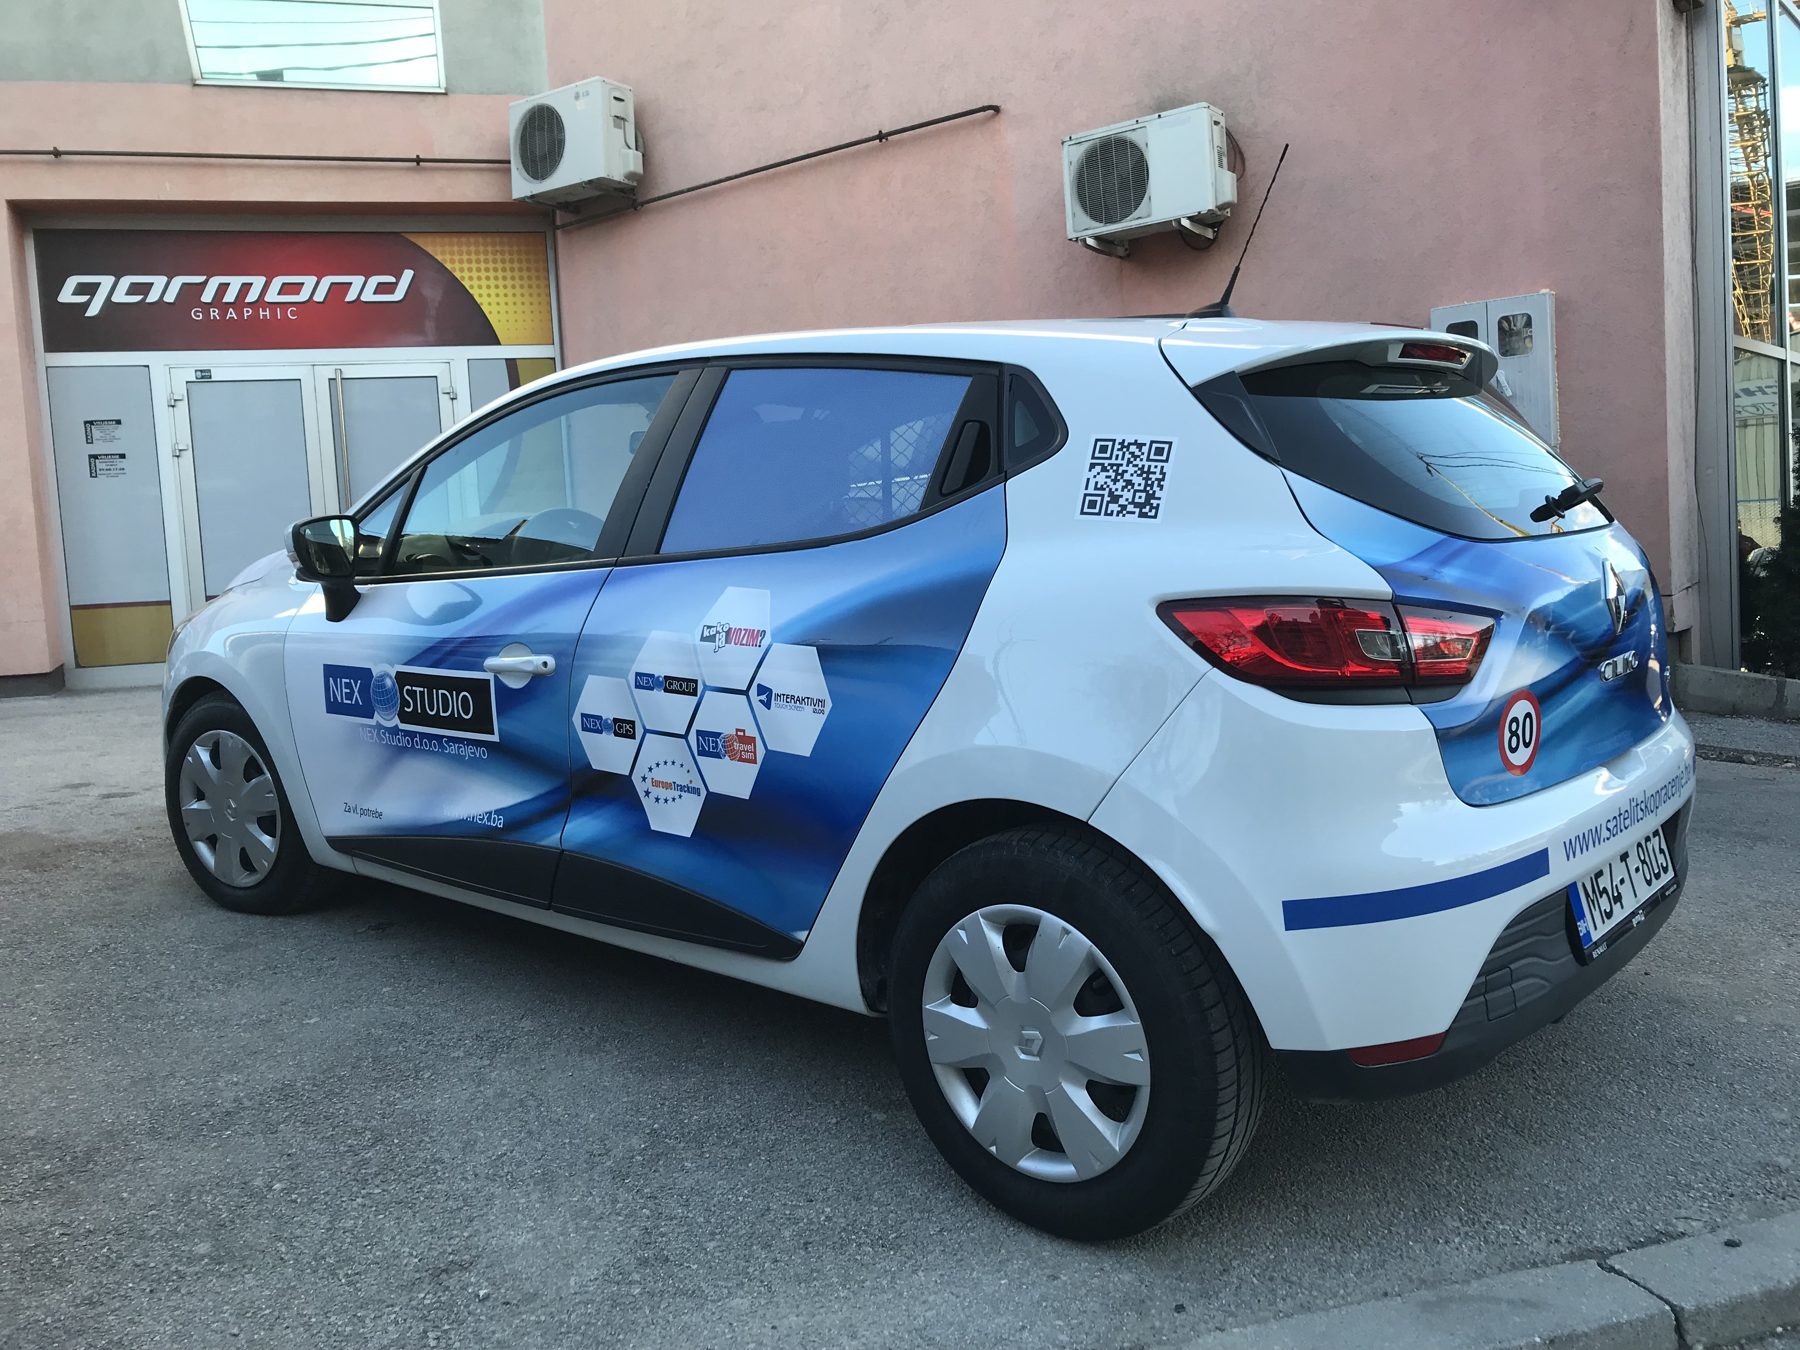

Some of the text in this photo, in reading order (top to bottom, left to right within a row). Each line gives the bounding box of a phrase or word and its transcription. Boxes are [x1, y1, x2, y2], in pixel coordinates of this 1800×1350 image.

[190, 307, 299, 320] GRAPHIC
[636, 676, 696, 693] NEX GROUP
[329, 677, 474, 720] NEX STUDIO
[774, 692, 826, 709] INTERAKTIVNI
[582, 717, 634, 735] NEX GPS
[1507, 711, 1534, 754] 80
[359, 727, 488, 760] NEX Studio d.o.o. Sarajevo
[698, 735, 754, 753] NEX travel
[741, 751, 755, 760] sim
[359, 806, 383, 820] potrebe
[1582, 828, 1669, 931] M54-T-803
